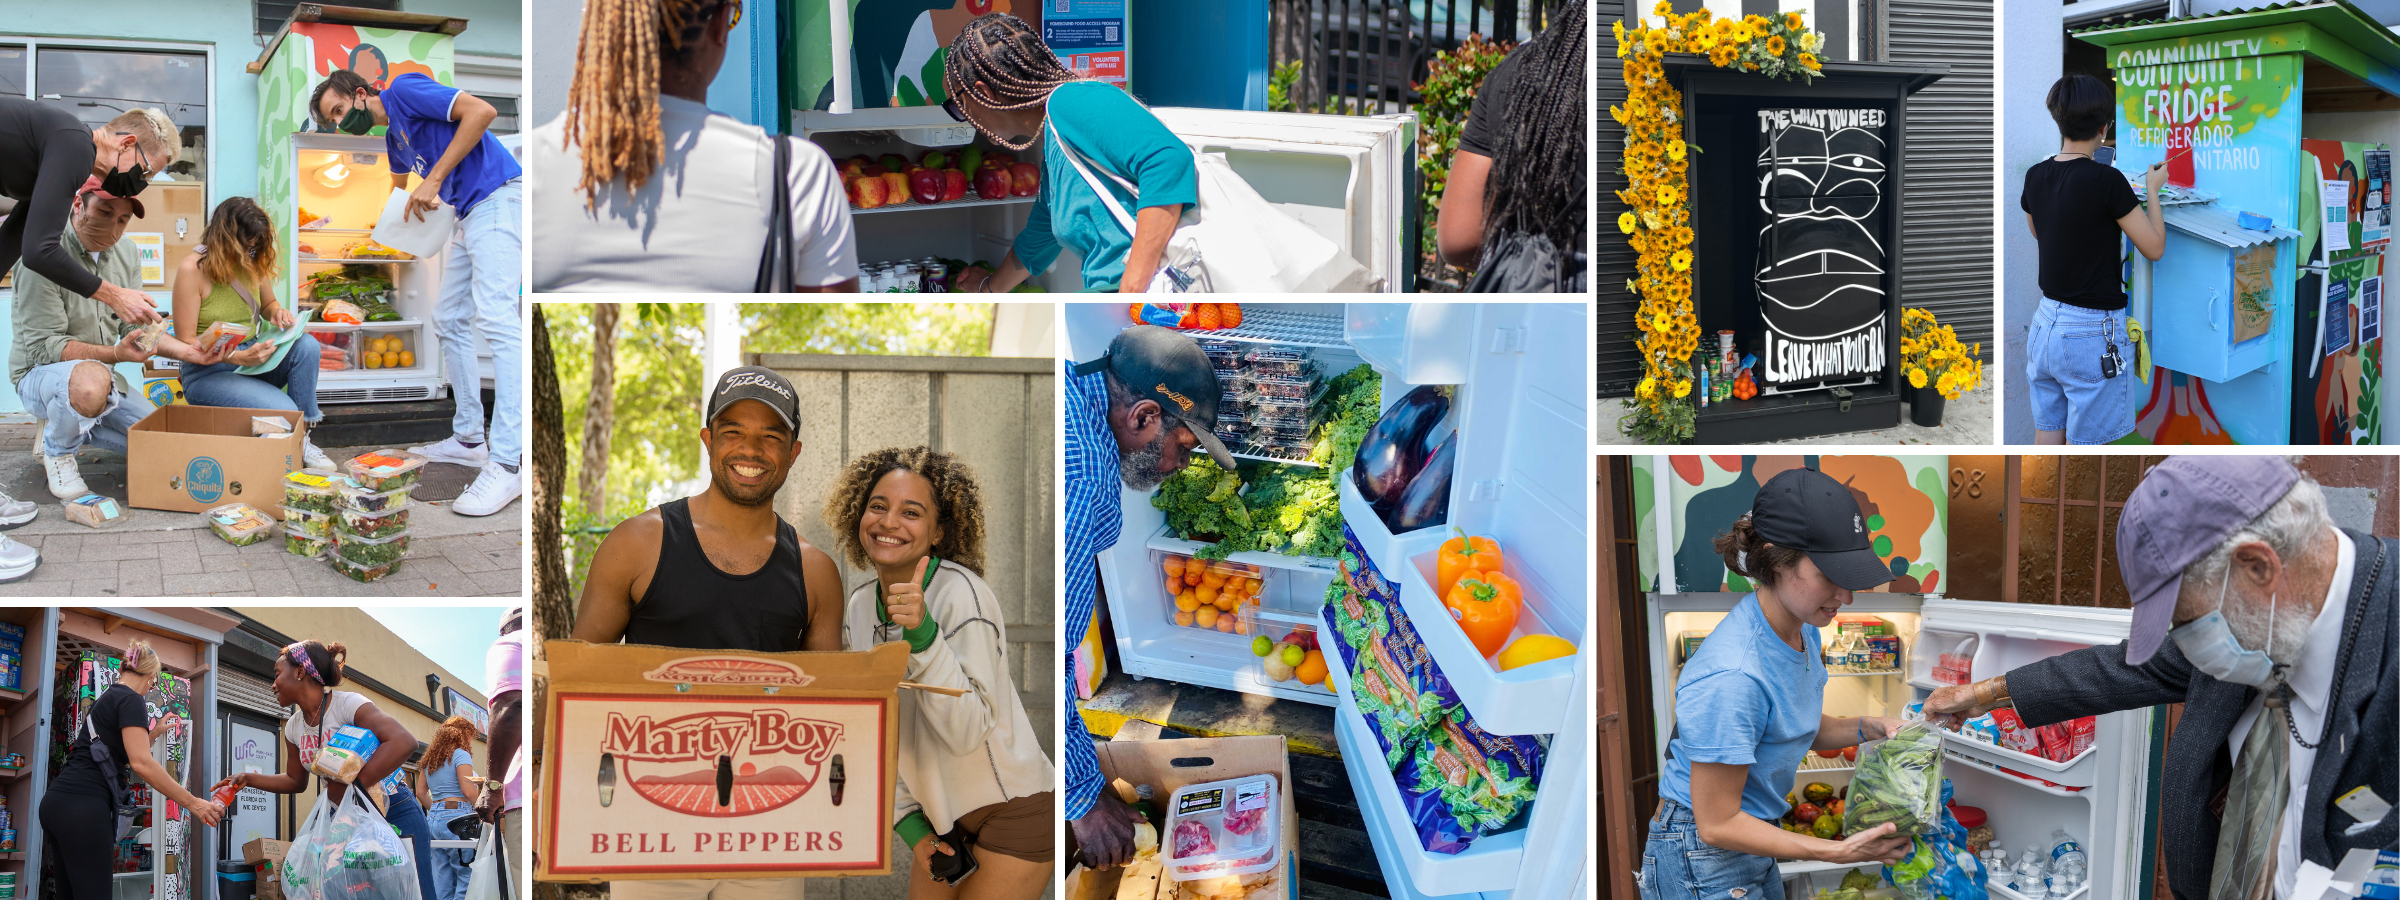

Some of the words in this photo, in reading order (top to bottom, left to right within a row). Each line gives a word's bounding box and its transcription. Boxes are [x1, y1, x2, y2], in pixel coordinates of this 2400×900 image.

[1046, 28, 1053, 39] 2
[2117, 37, 2263, 87] COMMUNITY
[2144, 85, 2233, 124] FRIDGE
[1758, 110, 1790, 133] TAKE
[1791, 109, 1827, 129] WHAT
[1828, 109, 1848, 131] YOU
[1848, 109, 1886, 128] NEED
[2130, 124, 2234, 149] REFRIGERADOR
[1765, 330, 1811, 383] LEAVE
[1812, 342, 1841, 376] WHAT
[1841, 333, 1862, 376] YOU
[1862, 315, 1885, 373] CAN
[721, 372, 791, 400] Titleist
[187, 480, 222, 495] Chiquita
[1951, 467, 1986, 499] 98
[603, 713, 748, 765] Marty
[752, 710, 843, 763] Boy
[591, 833, 676, 853] BELL
[694, 831, 843, 852] PEPPERS
